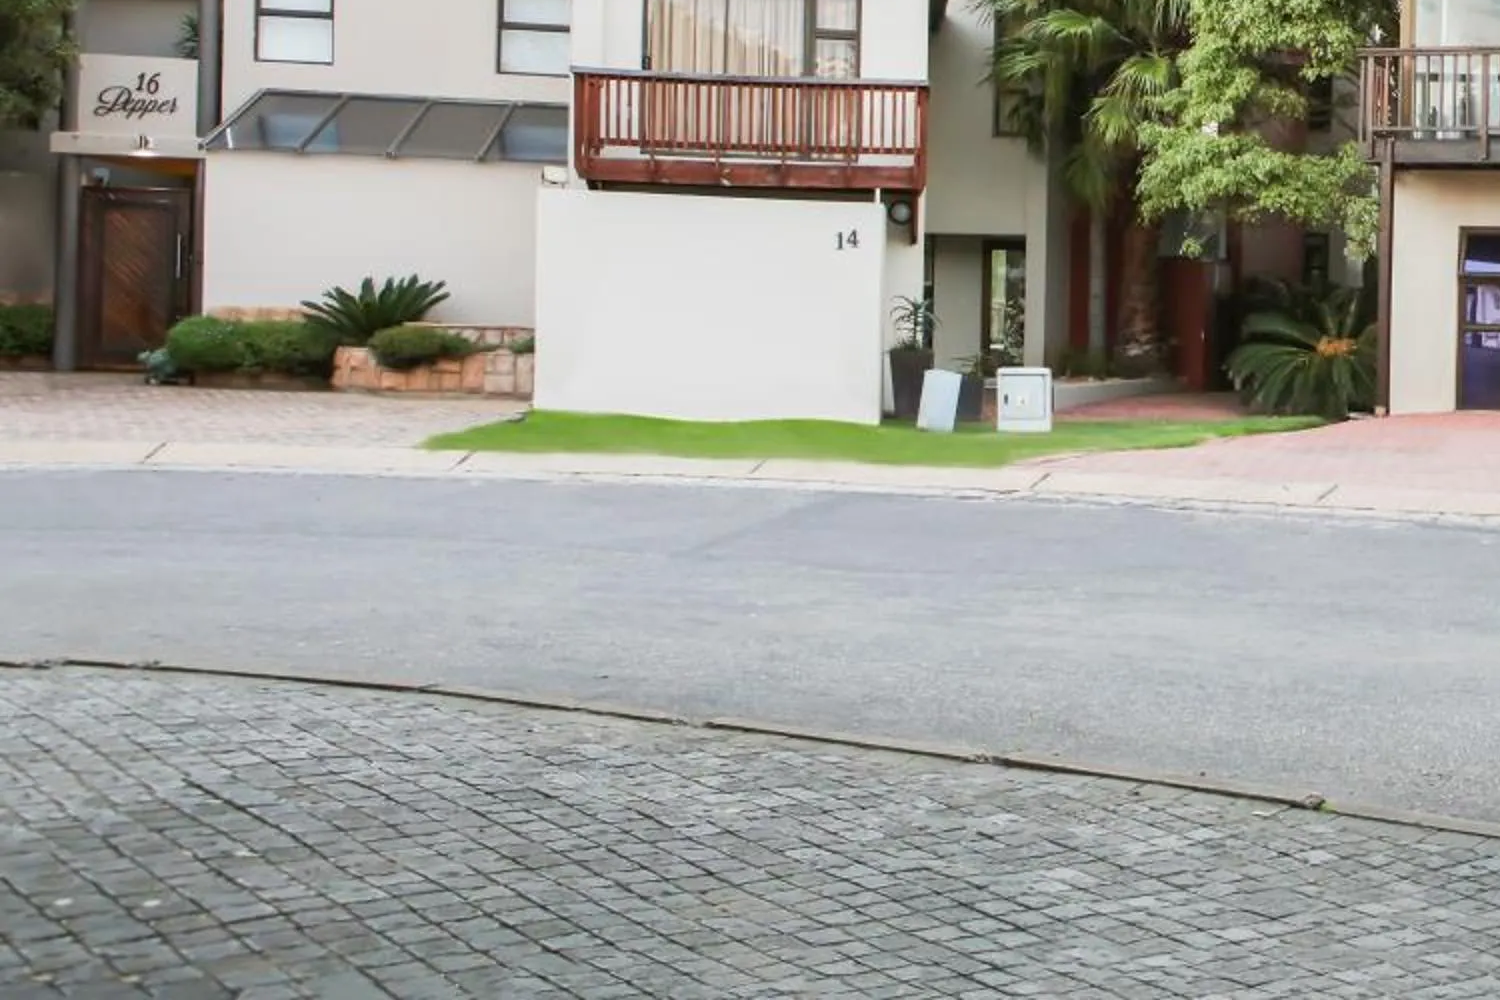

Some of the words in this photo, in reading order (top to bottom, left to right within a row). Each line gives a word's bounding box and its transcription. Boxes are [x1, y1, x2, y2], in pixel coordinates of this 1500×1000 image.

[135, 72, 161, 95] 16
[93, 85, 177, 120] Pepper
[834, 229, 860, 251] 14
